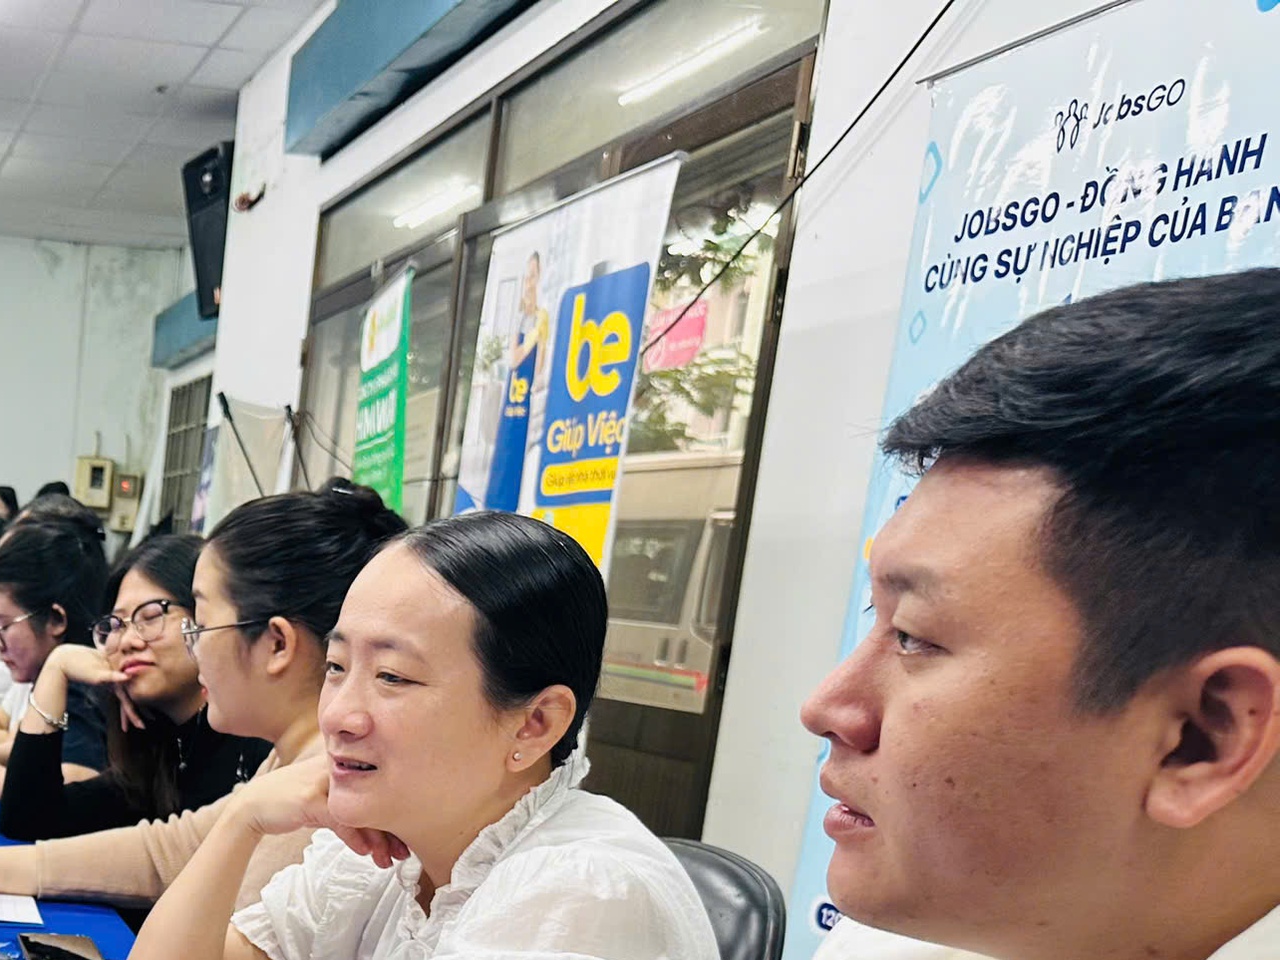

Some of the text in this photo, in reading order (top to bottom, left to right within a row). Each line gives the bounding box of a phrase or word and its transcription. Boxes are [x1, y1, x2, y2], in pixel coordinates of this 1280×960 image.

[953, 191, 1060, 243] JOBSGO
[994, 242, 1037, 284] SỰ
[1039, 213, 1142, 271] NGHIỆP
[1148, 196, 1207, 248] CỦA
[565, 293, 632, 402] be
[546, 418, 585, 458] Giúp
